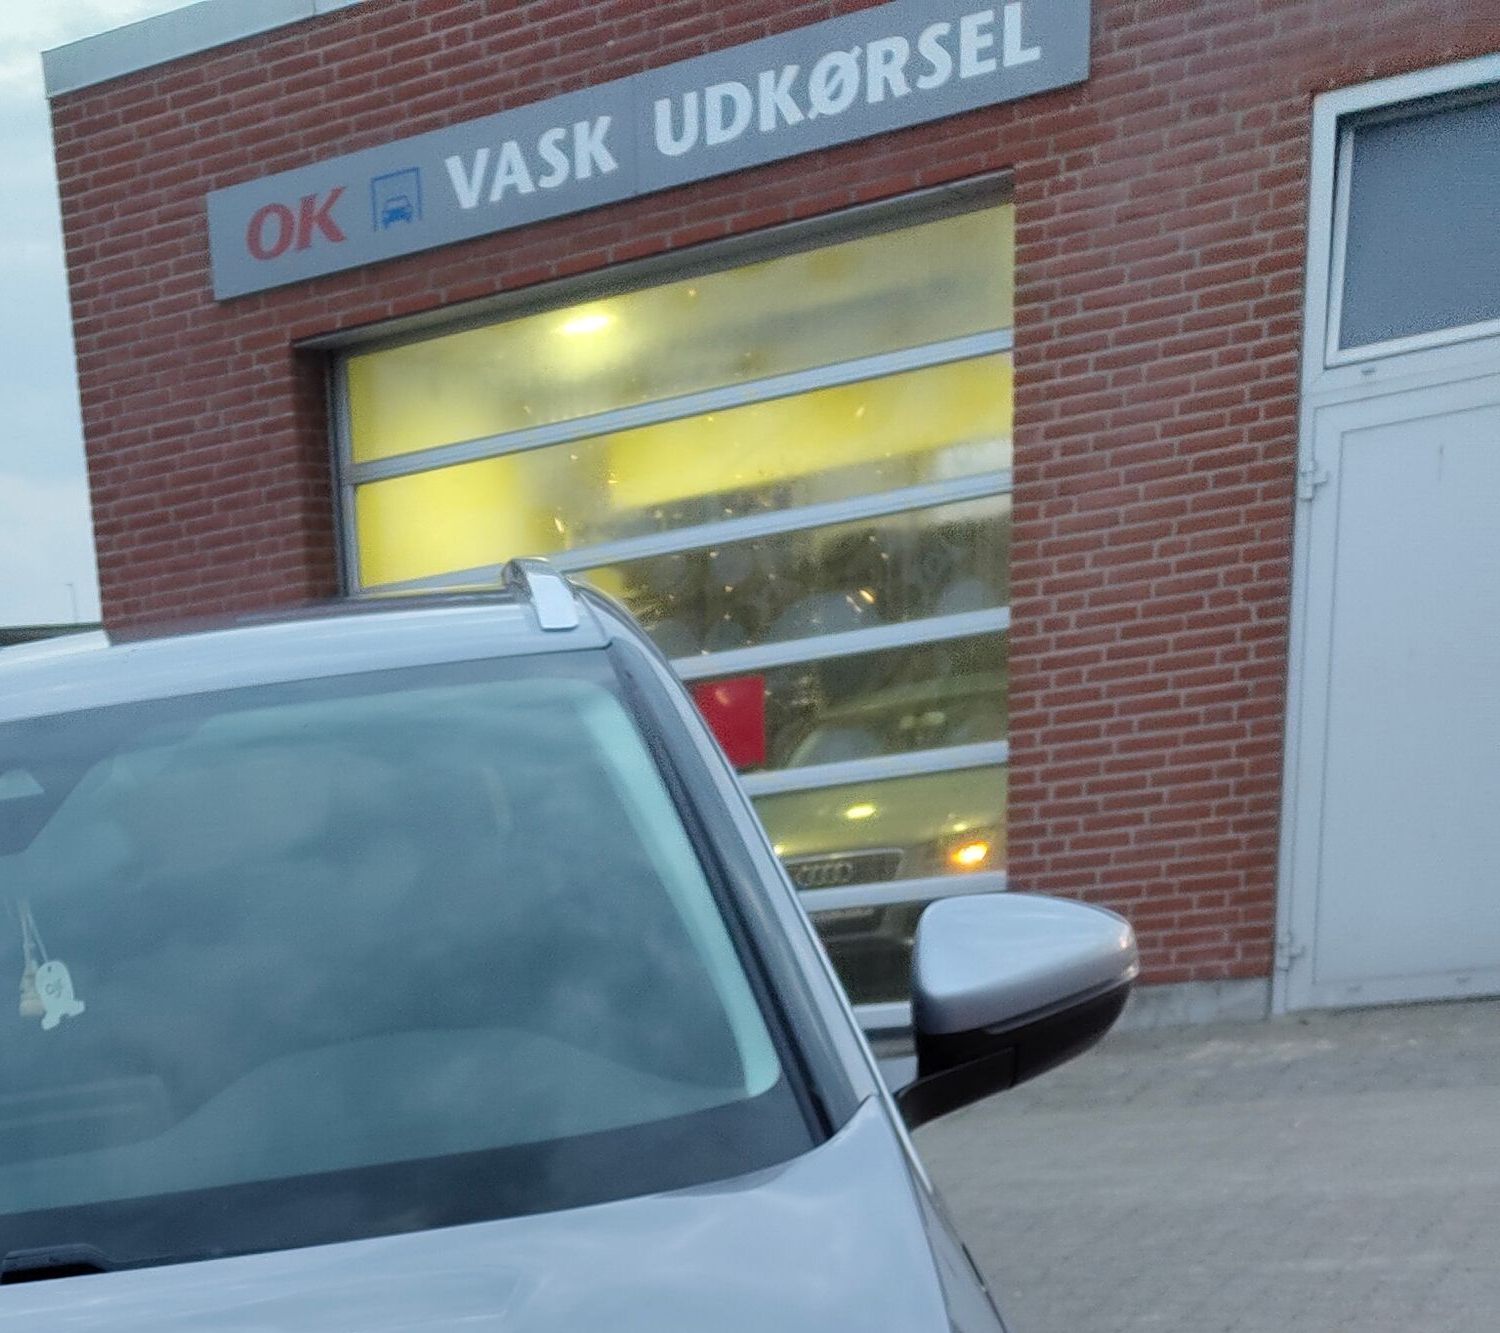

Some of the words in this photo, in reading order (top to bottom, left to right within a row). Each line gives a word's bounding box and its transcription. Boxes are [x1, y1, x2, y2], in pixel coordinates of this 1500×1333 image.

[245, 186, 348, 263] OK
[444, 115, 619, 211] VASK
[652, 1, 1042, 157] UDKØRSEL
